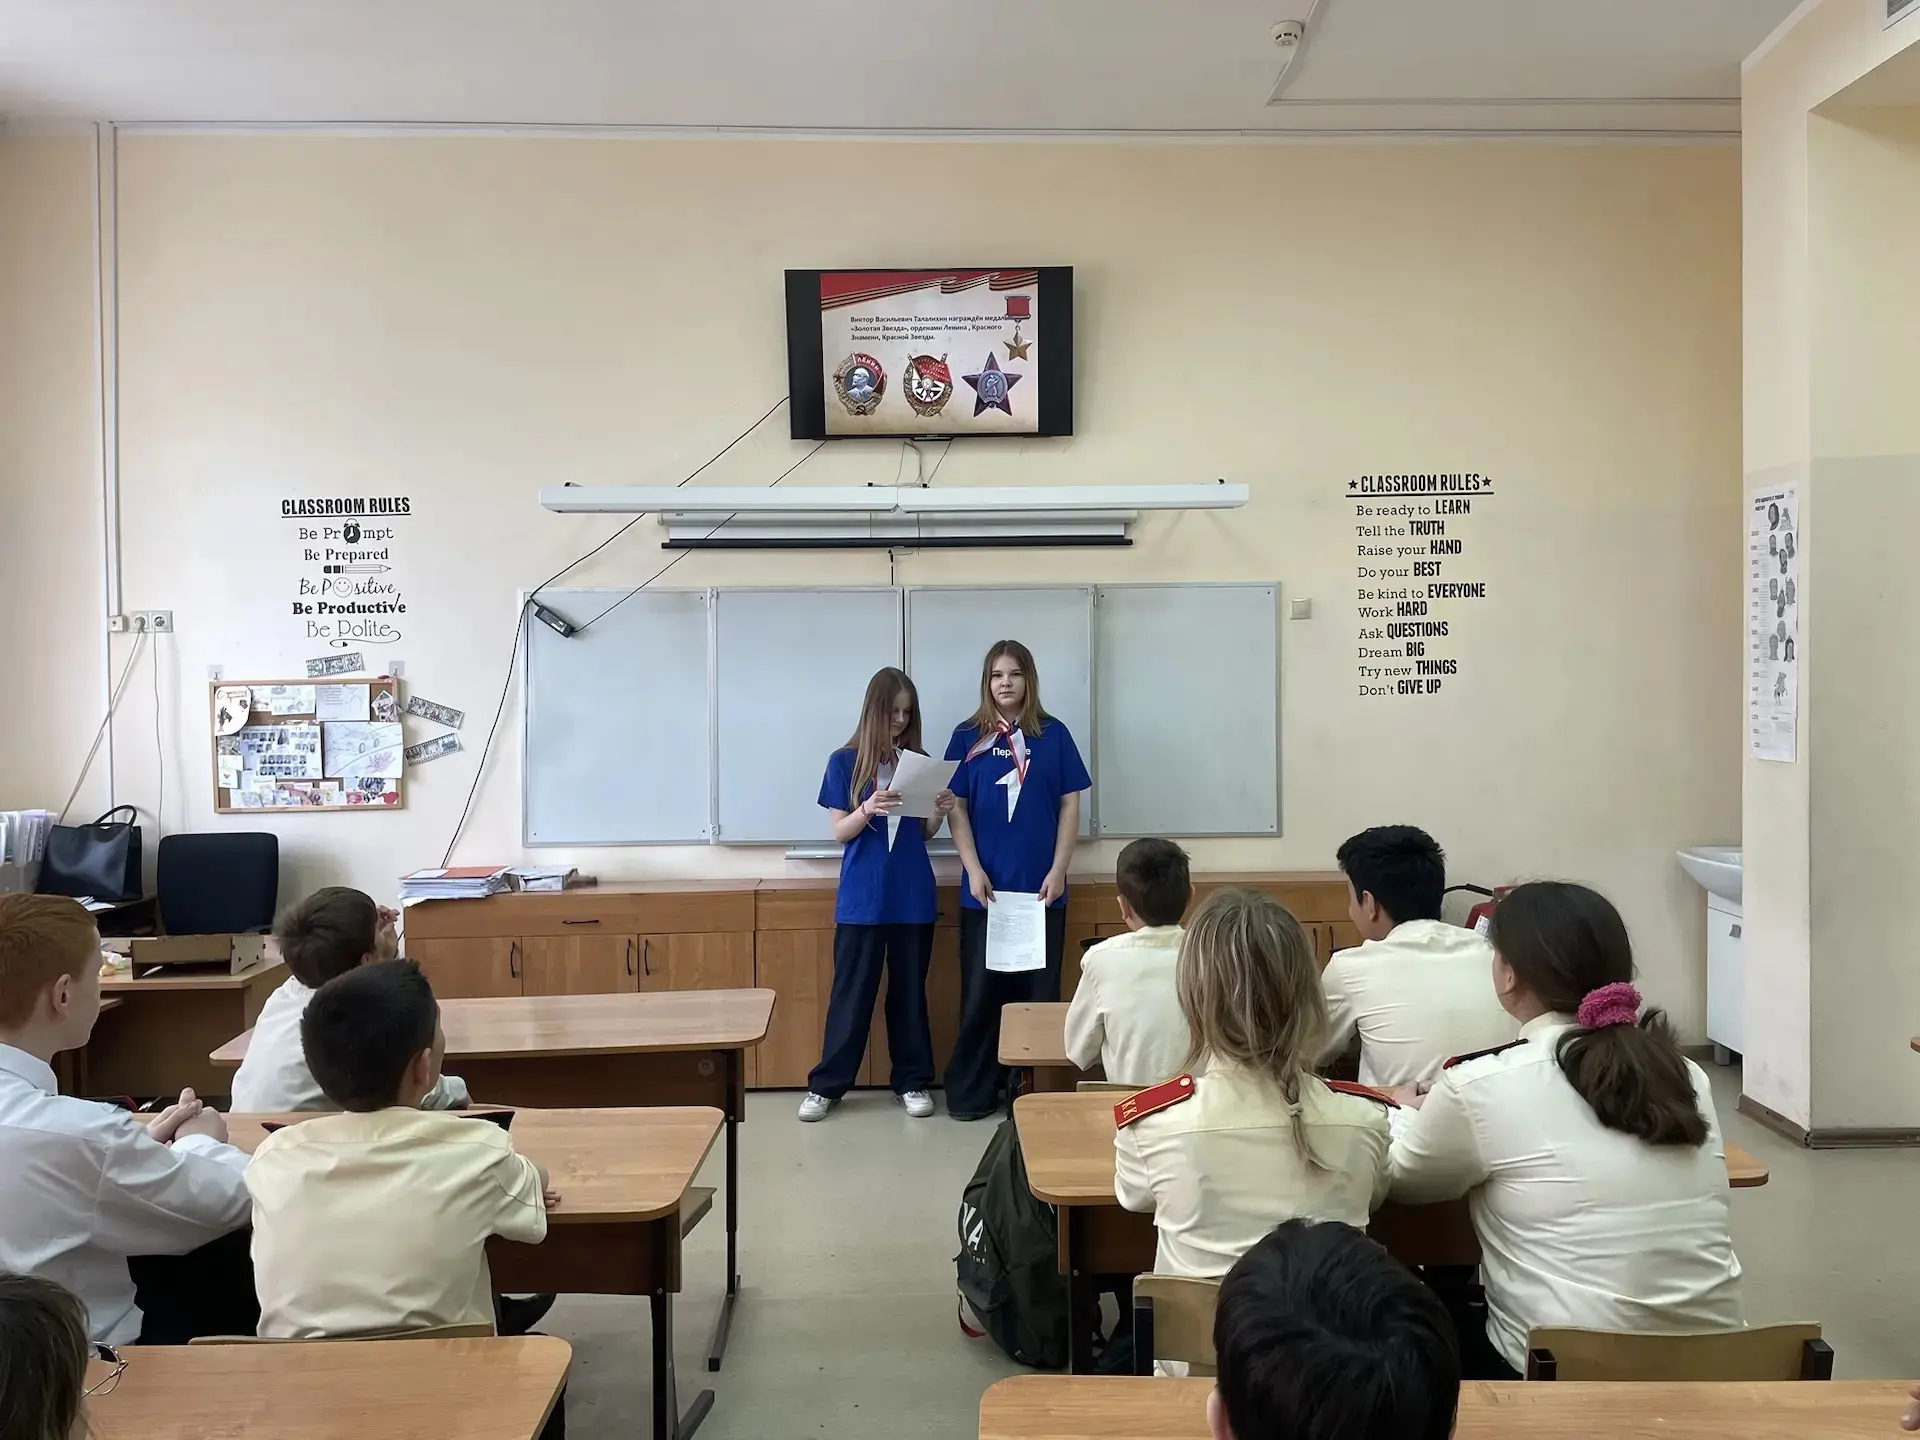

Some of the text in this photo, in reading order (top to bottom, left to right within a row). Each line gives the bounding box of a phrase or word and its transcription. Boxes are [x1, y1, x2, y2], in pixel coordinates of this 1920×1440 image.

[1361, 474, 1480, 493] CLASSROOM RULES
[281, 497, 410, 515] CLASSROOM RULES
[1356, 499, 1470, 518] Be ready to LEARN
[299, 528, 318, 540] Be
[1356, 521, 1444, 536] Tell the TRUTH
[304, 548, 389, 563] Be Prepared
[1357, 540, 1462, 557] Raise your HAND
[1358, 562, 1441, 580] Do your BEST
[299, 577, 319, 595] Be
[1358, 583, 1485, 599] Be kind to EVERYONE
[292, 593, 406, 614] Be Productive
[1358, 601, 1427, 617] Work HARD
[306, 620, 330, 637] Be
[1358, 621, 1449, 639] Ask QUESTIONS
[1358, 642, 1425, 658] Dream BIG
[1359, 659, 1457, 678] Try new THINGS
[1359, 679, 1441, 696] Don't GIVE UP
[992, 747, 1031, 758] Пере
